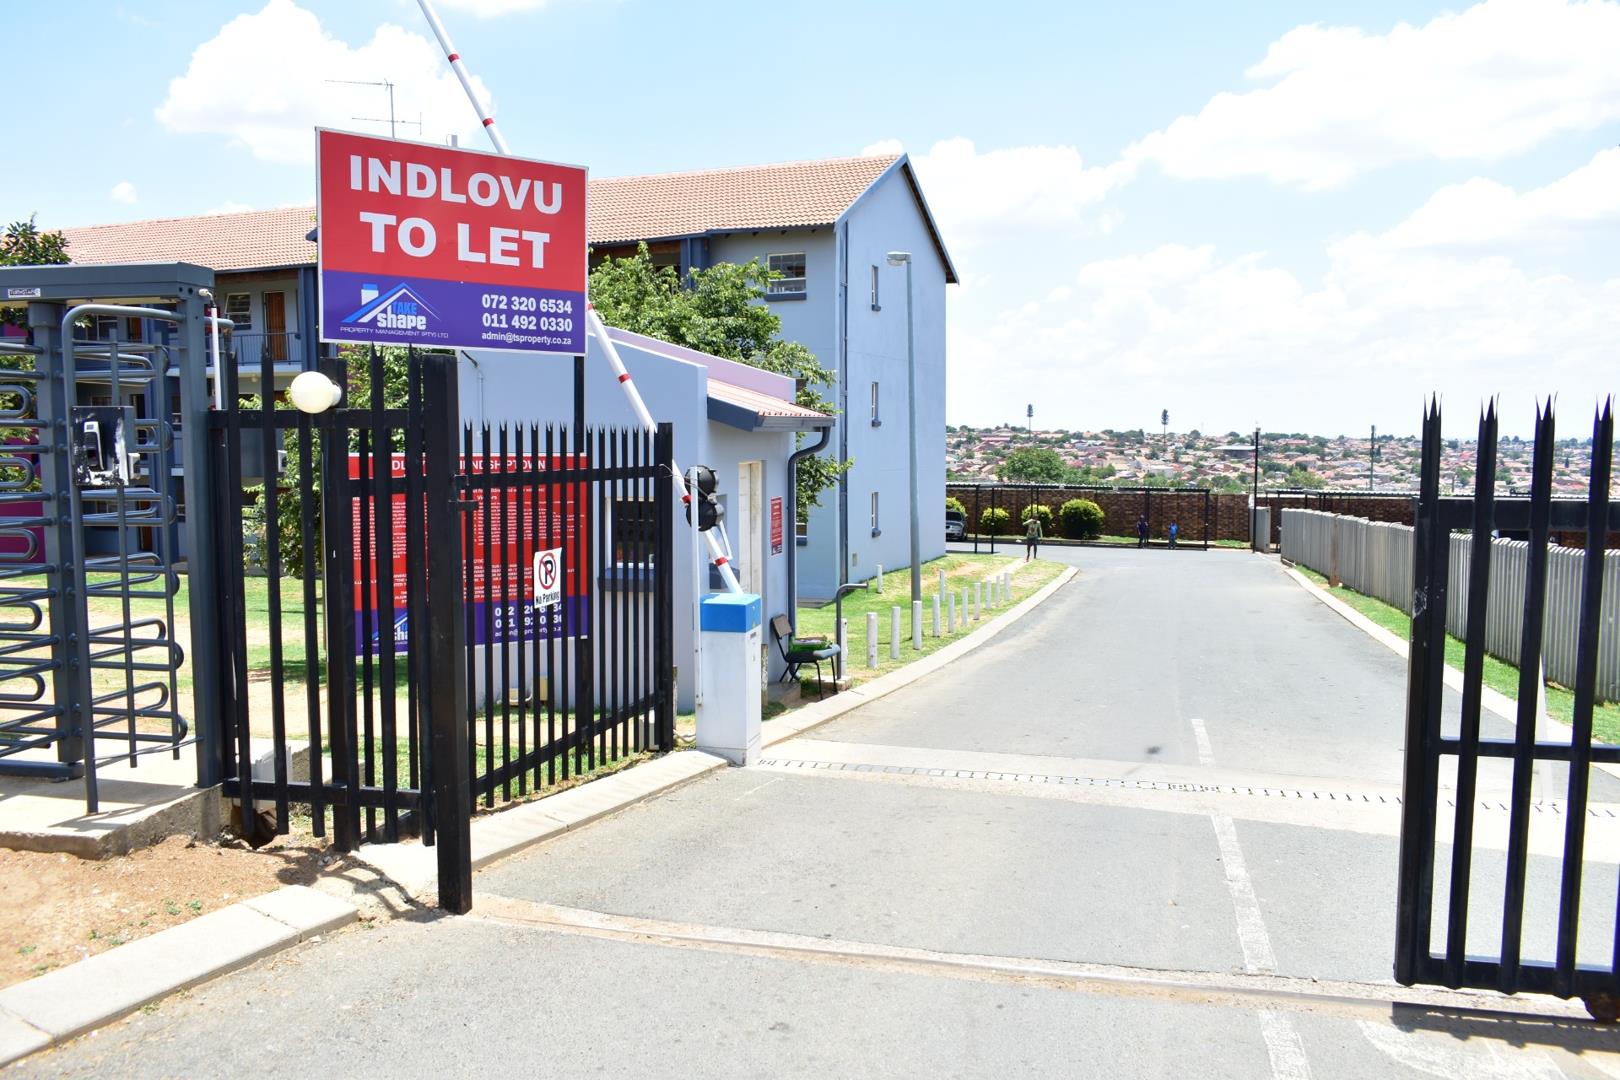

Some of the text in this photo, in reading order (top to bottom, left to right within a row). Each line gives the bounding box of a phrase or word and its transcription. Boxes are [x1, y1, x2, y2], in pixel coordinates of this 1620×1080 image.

[350, 154, 563, 215] INDLOVU
[359, 211, 550, 269] TO LET
[393, 301, 418, 315] TAKE
[482, 294, 572, 315] 072 320 6534
[377, 304, 427, 331] shape
[482, 312, 573, 333] 011 492 0330
[340, 326, 374, 334] PROPERTY
[375, 328, 420, 338] MANAGEMENT
[437, 331, 449, 339] LTD
[481, 331, 572, 346] admin@tsproperty.co.za
[542, 590, 560, 604] Parking
